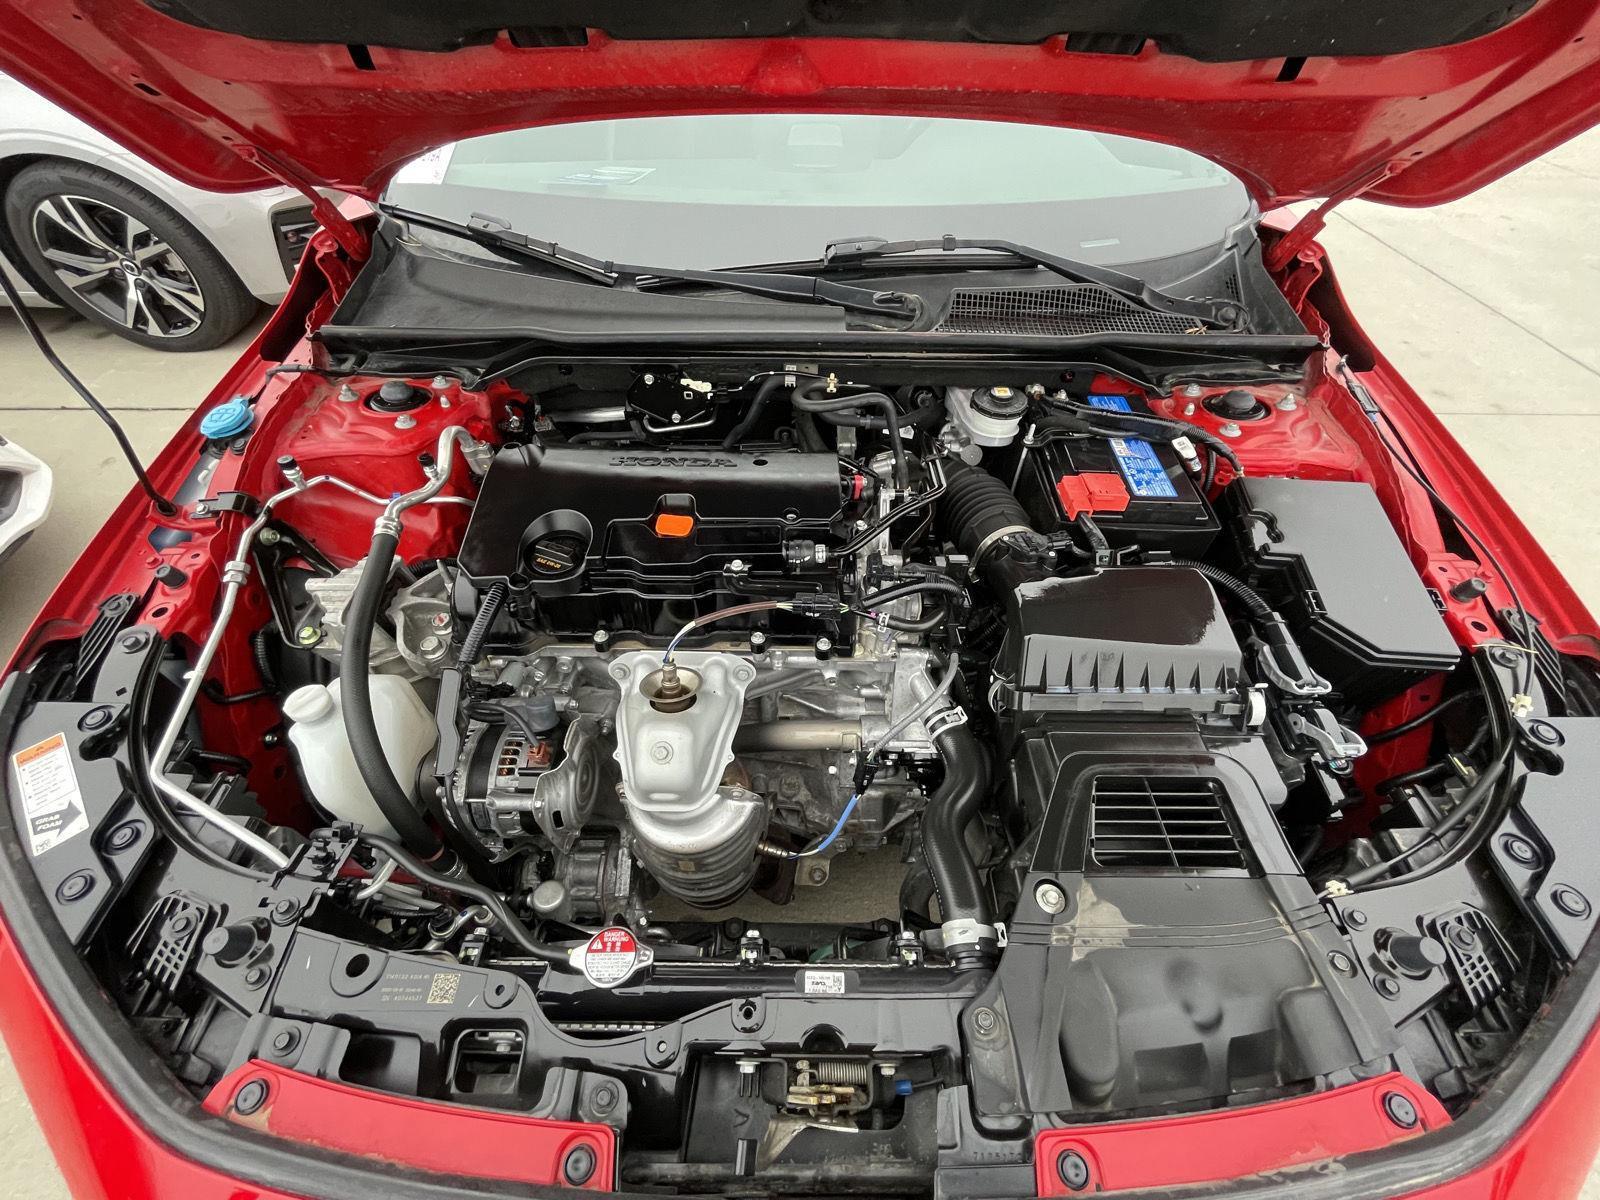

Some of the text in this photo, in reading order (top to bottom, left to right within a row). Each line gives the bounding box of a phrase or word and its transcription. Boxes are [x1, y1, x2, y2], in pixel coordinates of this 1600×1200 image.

[608, 456, 738, 468] HONDA
[35, 814, 60, 825] GRAB
[36, 820, 63, 832] FOAM
